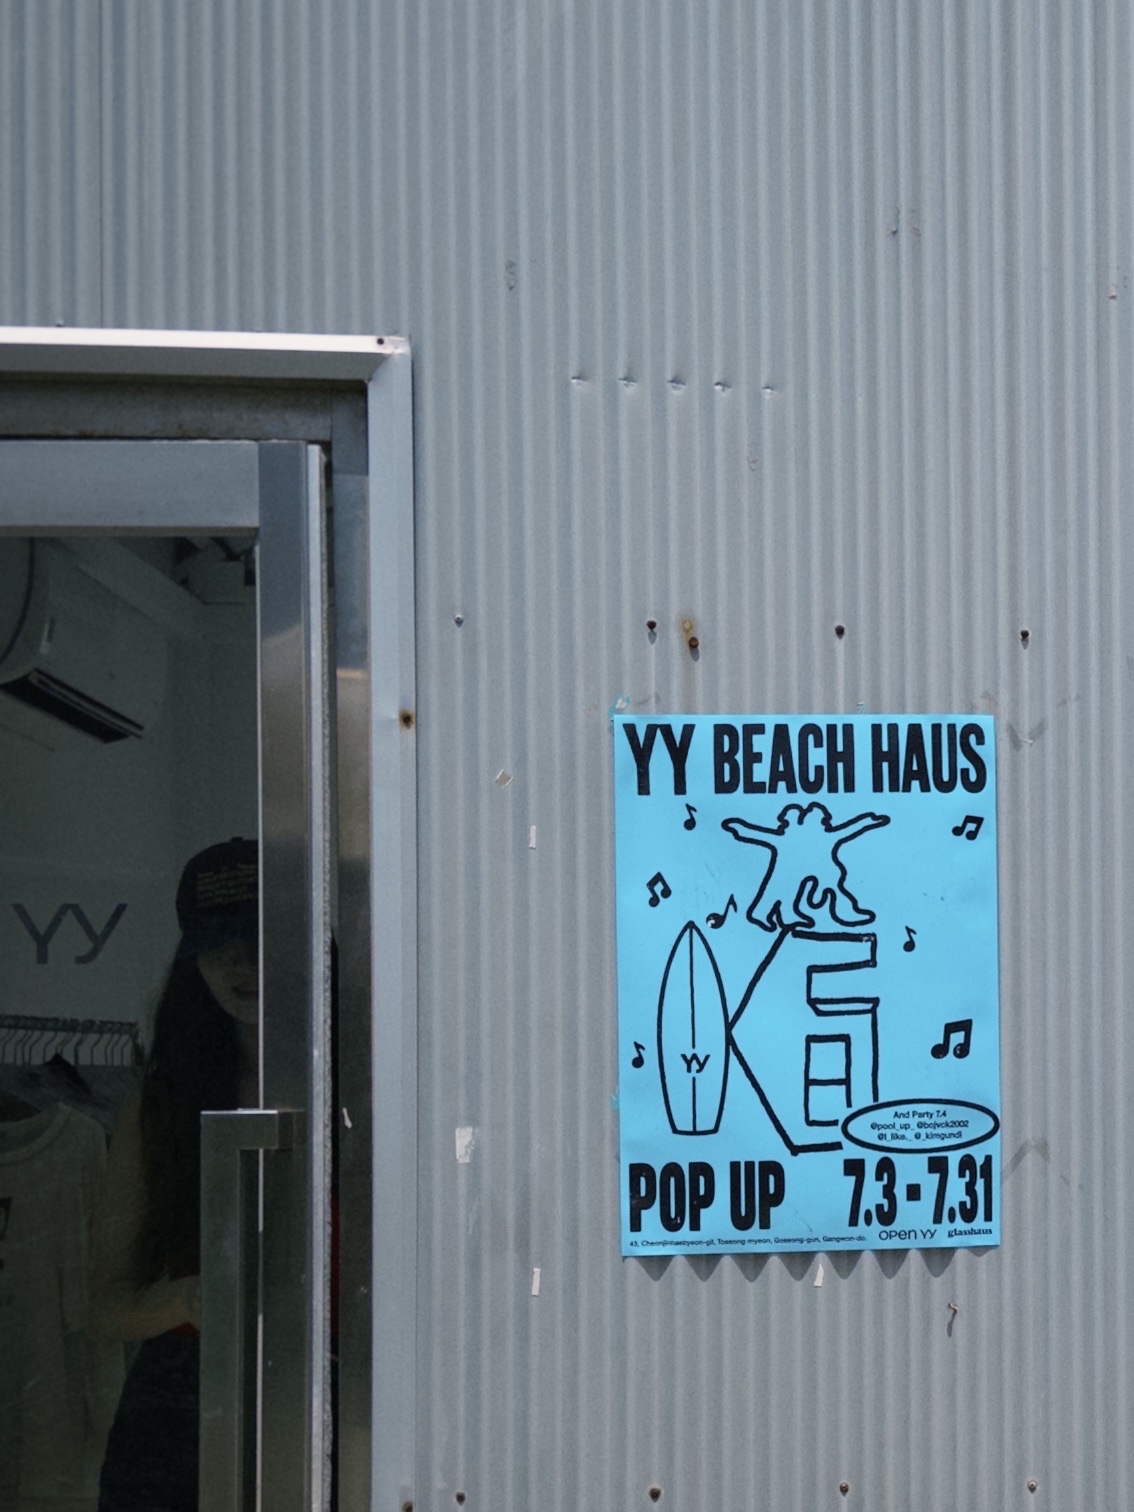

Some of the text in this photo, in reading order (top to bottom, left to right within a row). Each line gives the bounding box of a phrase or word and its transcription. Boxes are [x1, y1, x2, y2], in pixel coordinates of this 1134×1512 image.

[623, 722, 987, 796] YY BEACH HAUS
[893, 1110, 947, 1120] And Party 7.4
[629, 1160, 785, 1233] POP UP
[947, 1228, 993, 1239] glasshaus
